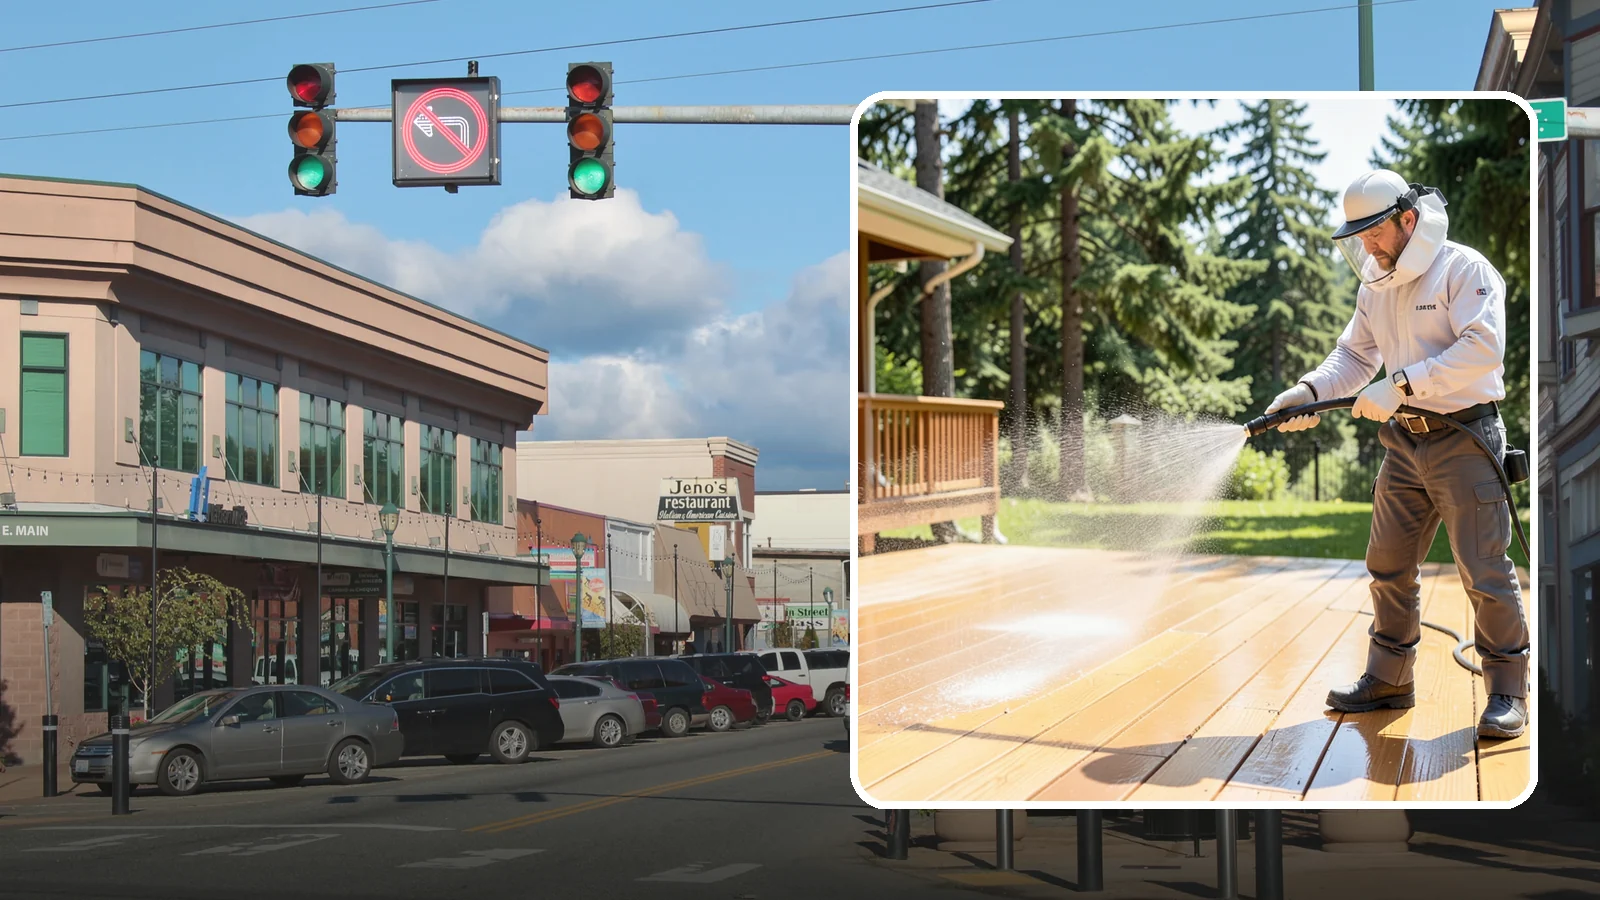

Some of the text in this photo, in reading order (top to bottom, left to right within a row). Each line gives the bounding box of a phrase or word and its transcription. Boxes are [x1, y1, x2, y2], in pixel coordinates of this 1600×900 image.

[670, 480, 727, 494] Jeno's
[665, 496, 731, 509] restaurant
[658, 509, 682, 519] Italian
[686, 509, 714, 519] American
[715, 509, 737, 519] Cuisine
[2, 525, 49, 536] E. MAIN
[797, 608, 828, 617] Street
